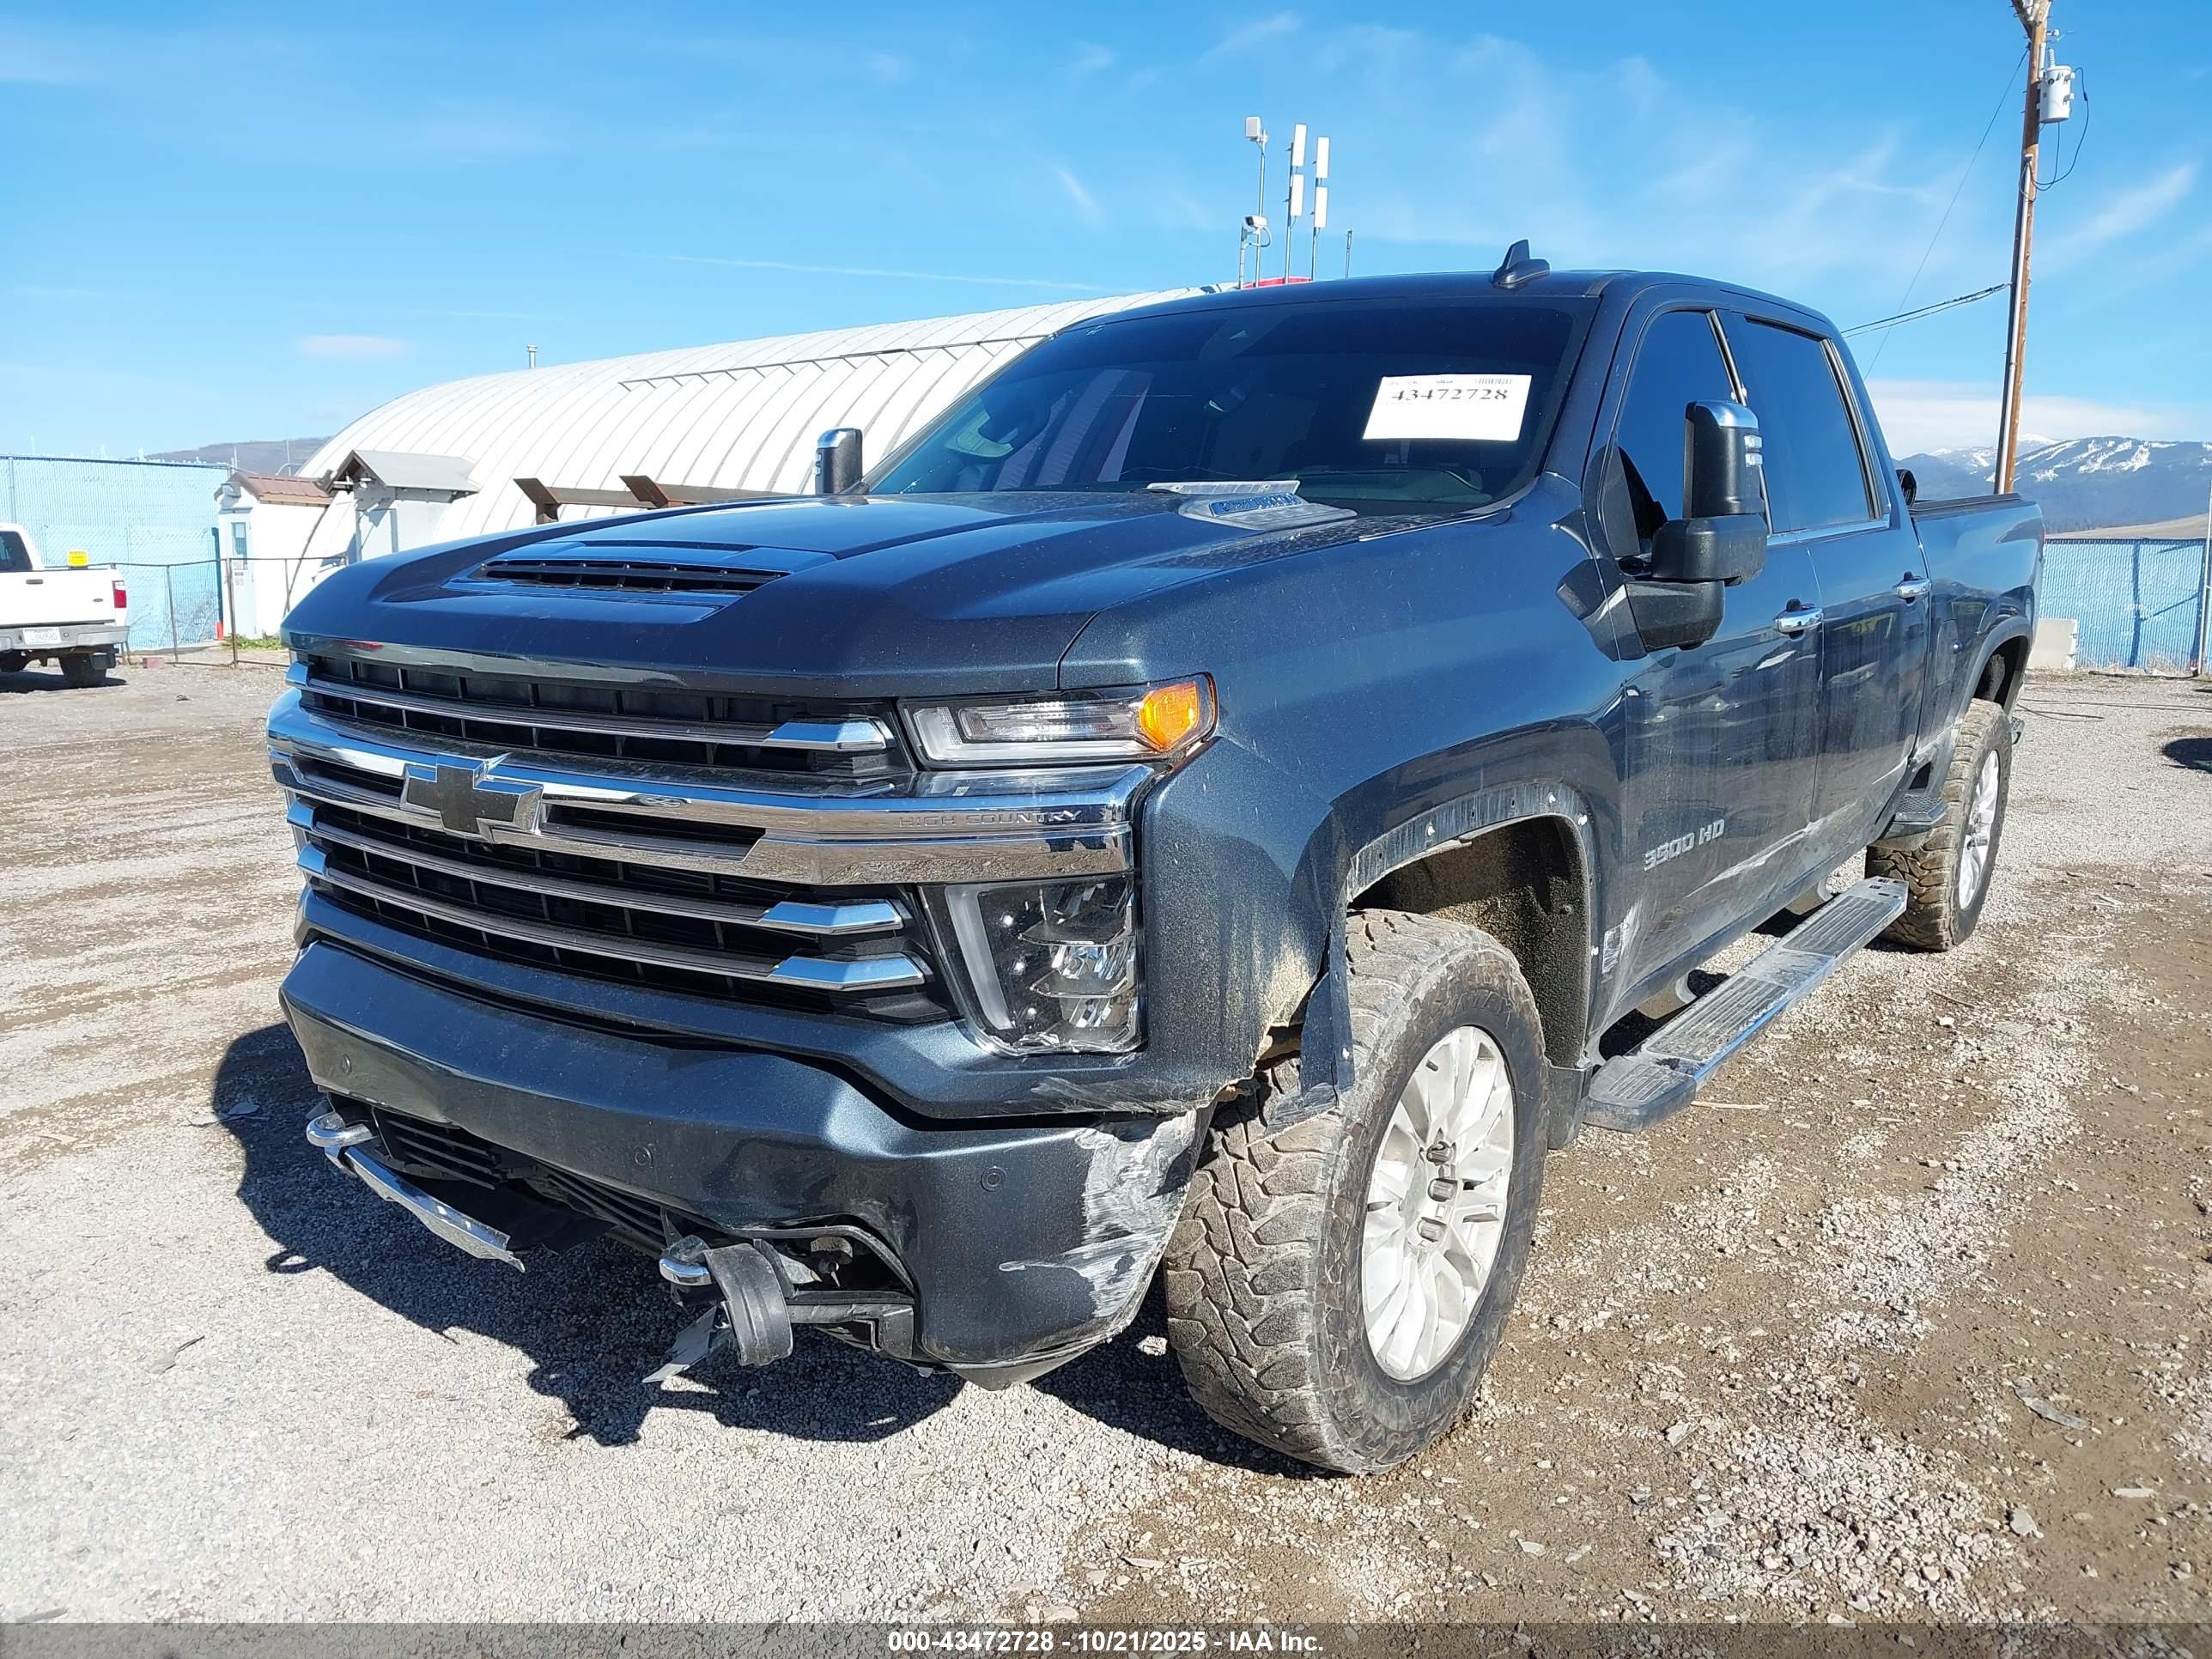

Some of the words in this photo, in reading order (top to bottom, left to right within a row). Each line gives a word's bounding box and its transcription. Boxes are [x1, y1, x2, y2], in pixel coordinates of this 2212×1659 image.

[1391, 388, 1509, 401] 43472728
[966, 810, 1083, 825] COUNTRY
[1643, 831, 1695, 872] 3500
[1698, 817, 1725, 846] HD
